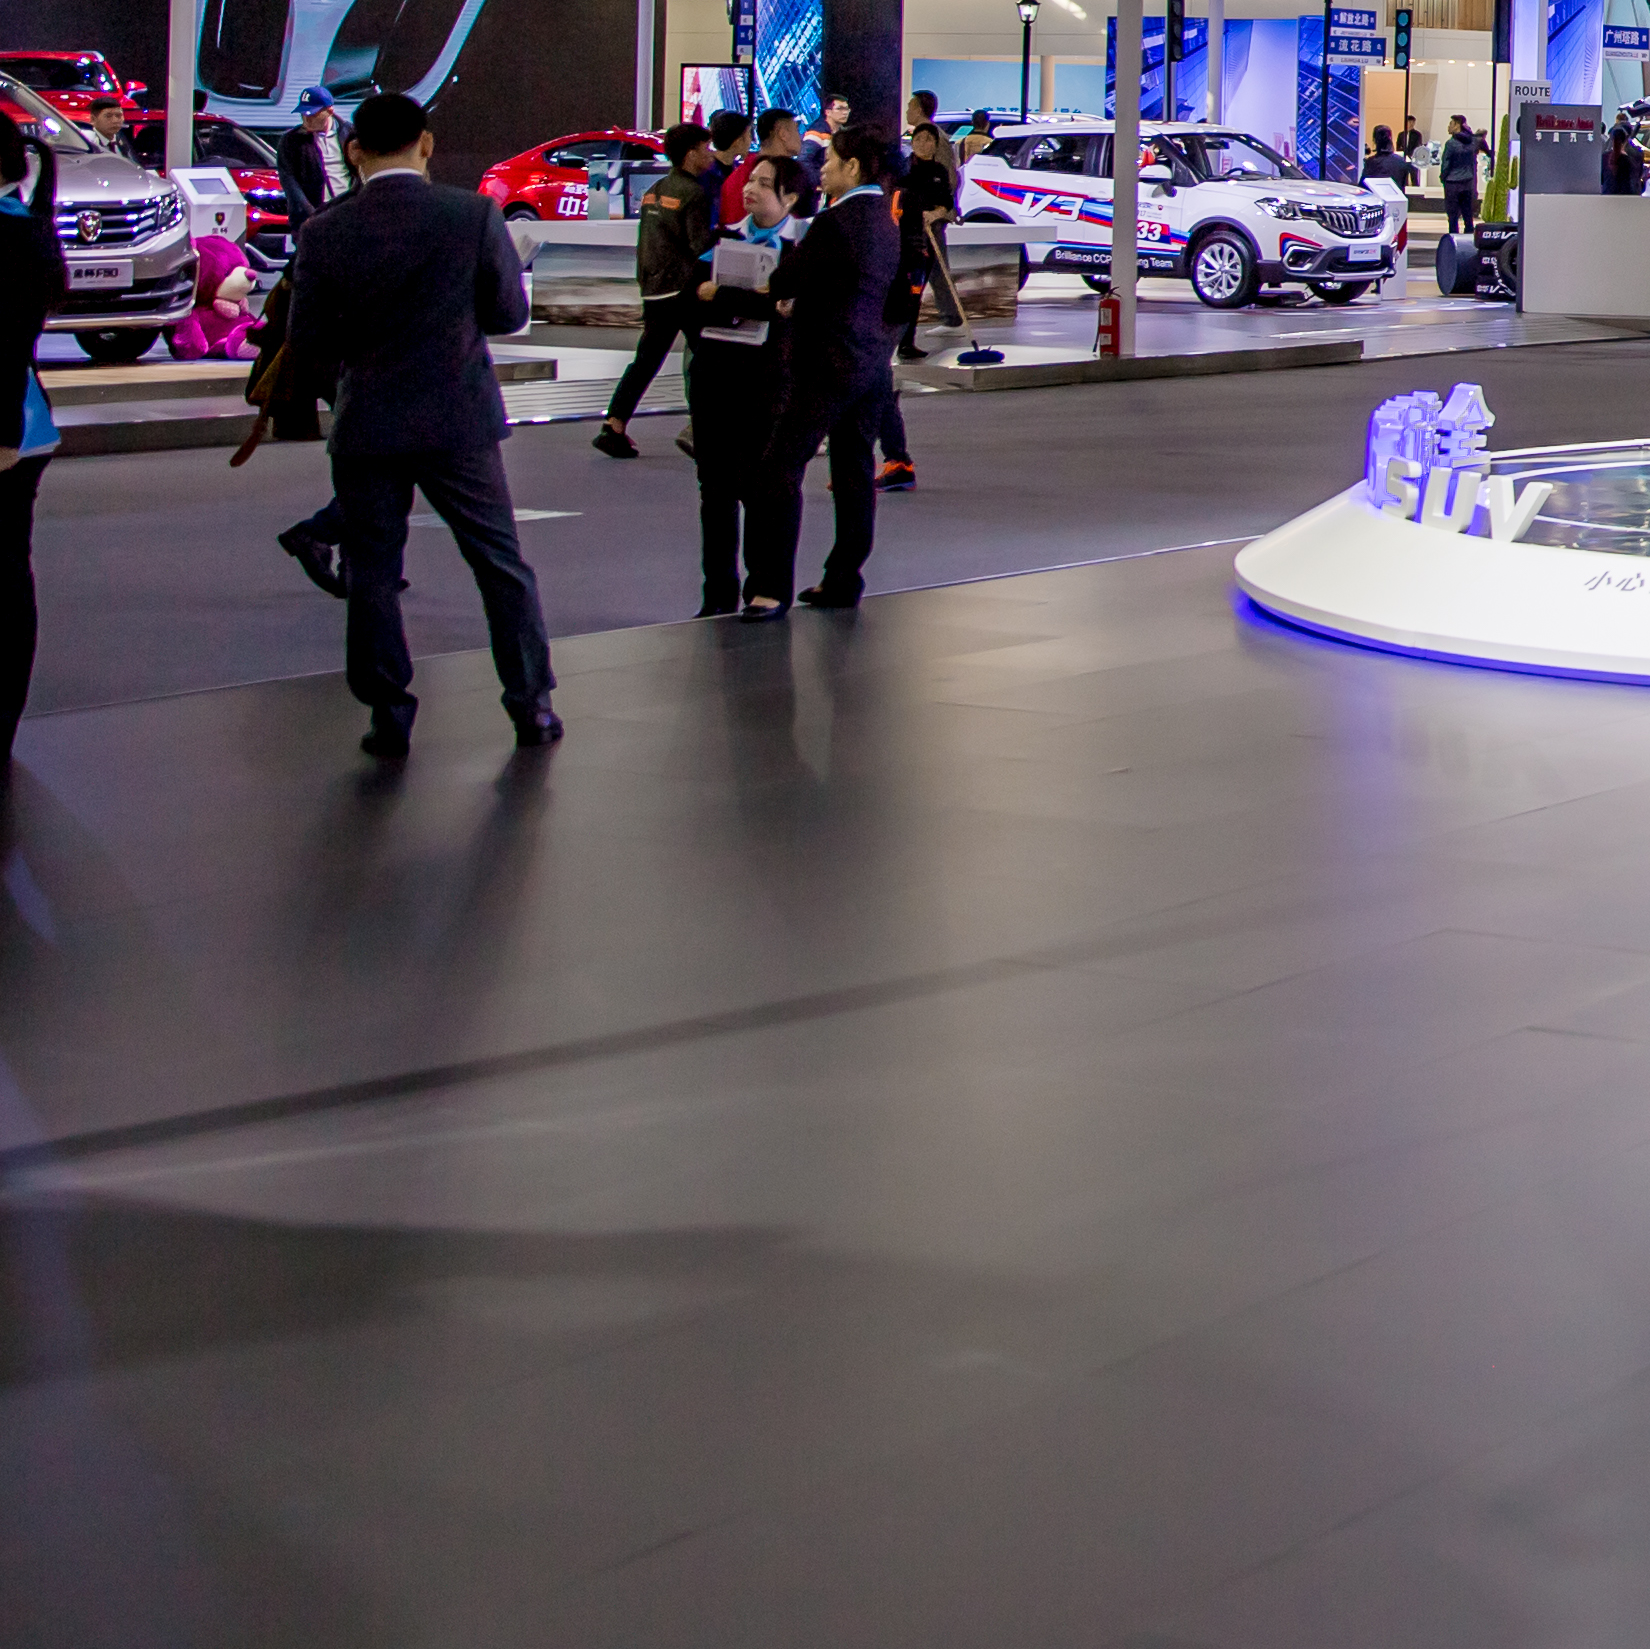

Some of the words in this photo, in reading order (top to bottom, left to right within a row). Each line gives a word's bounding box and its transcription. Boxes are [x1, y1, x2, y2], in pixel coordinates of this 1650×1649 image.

[1514, 85, 1550, 97] ROUTE
[1019, 192, 1085, 222] V3
[1382, 456, 1554, 543] SUV
